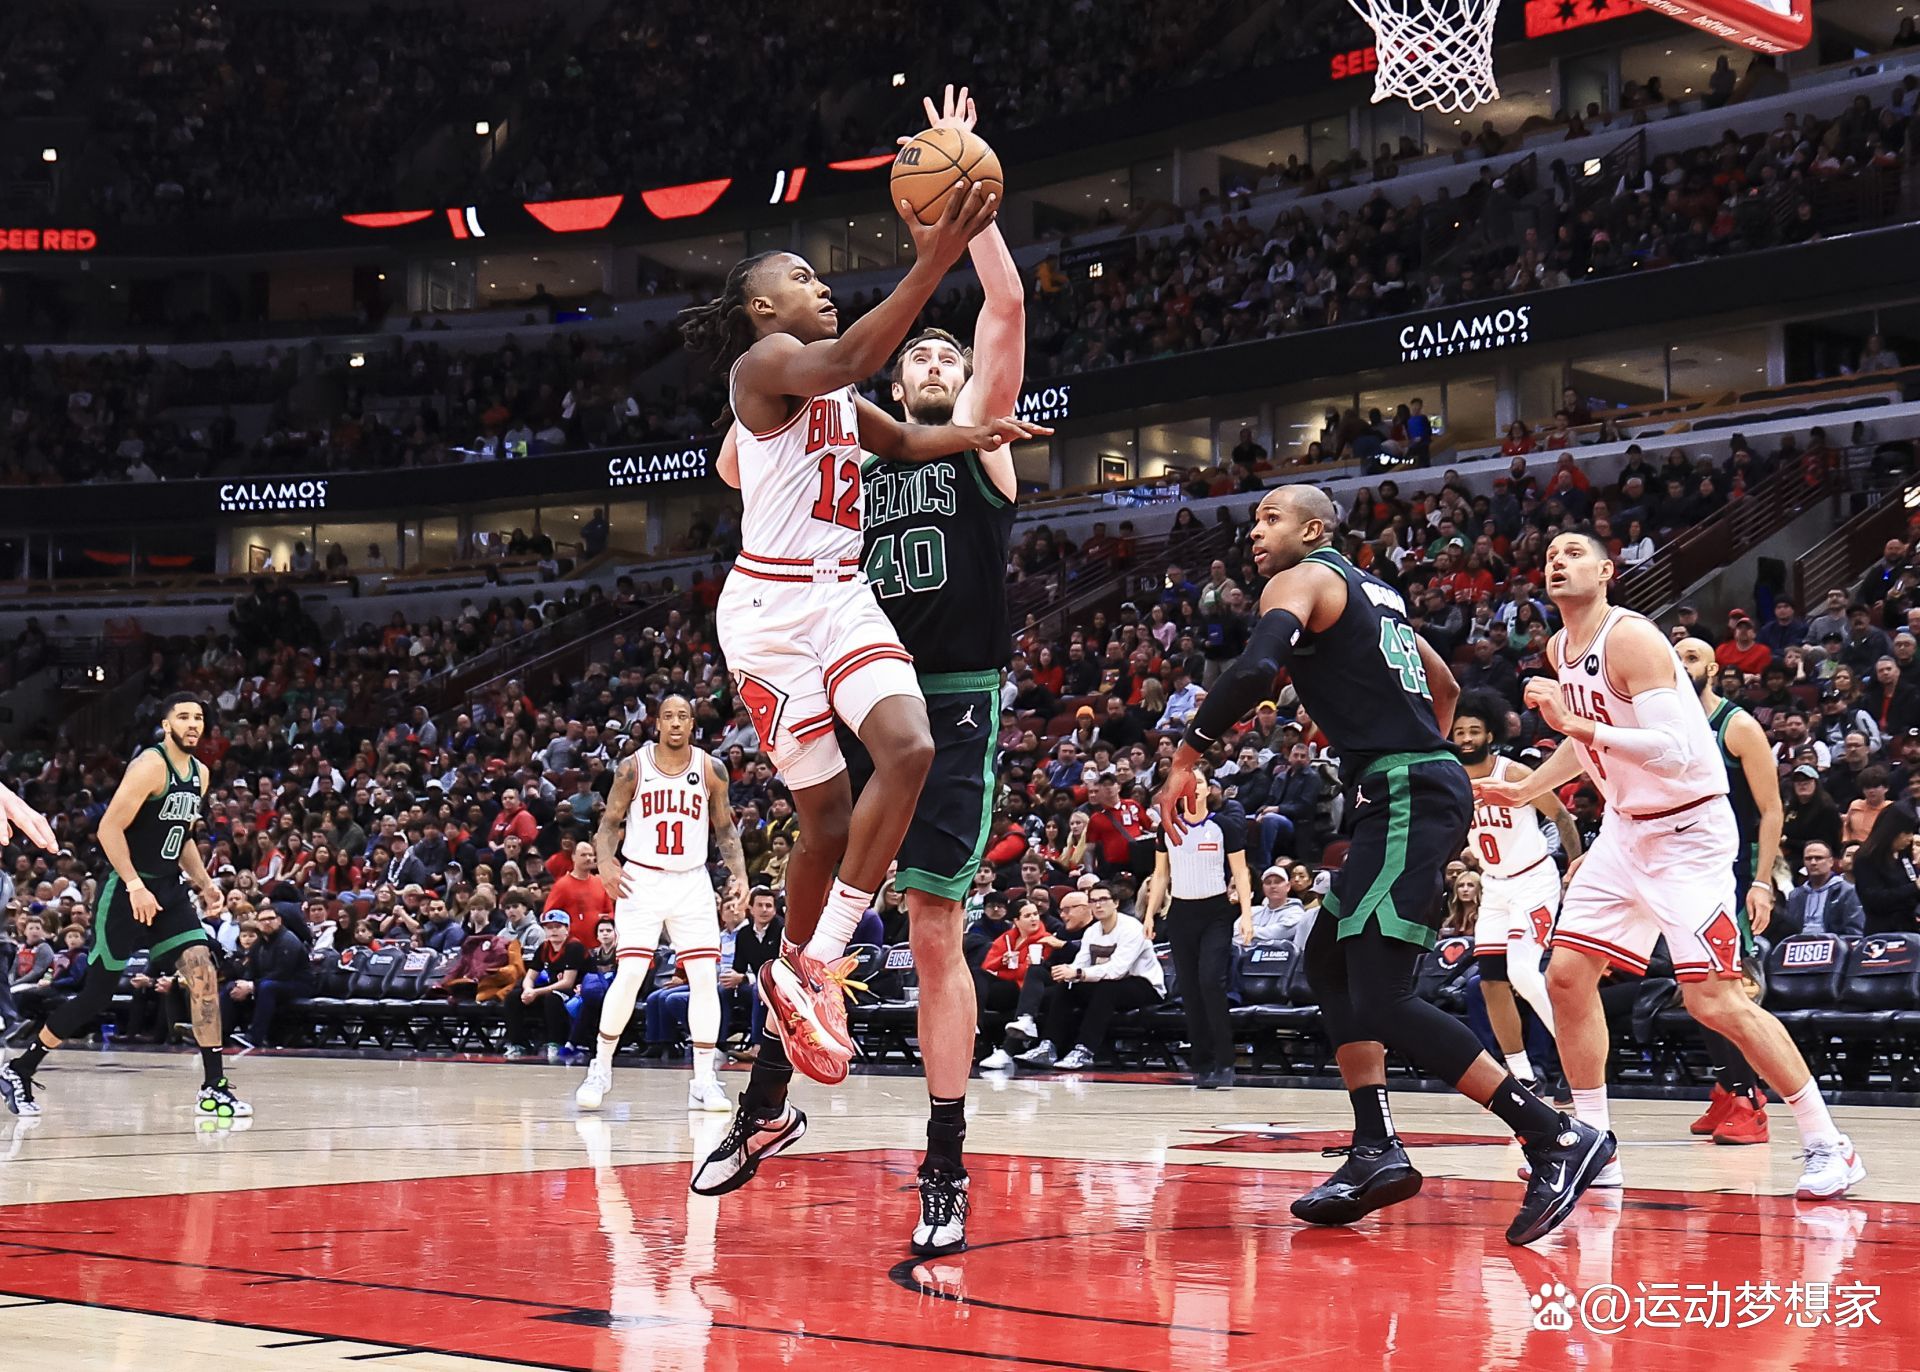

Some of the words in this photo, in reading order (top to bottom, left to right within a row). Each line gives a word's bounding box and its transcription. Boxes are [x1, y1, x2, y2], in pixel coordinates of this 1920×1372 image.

[43, 227, 97, 251] RED
[1399, 306, 1529, 349] CALAMOS
[608, 449, 706, 476] CALAMOS
[220, 481, 327, 501] CALAMOS
[811, 452, 861, 531] 12
[864, 526, 948, 599] 40
[641, 789, 702, 820] BULLS
[160, 825, 185, 860] 0
[655, 820, 684, 855] 11
[1478, 833, 1501, 865] 0
[892, 952, 911, 966] USO
[1794, 944, 1823, 962] USO
